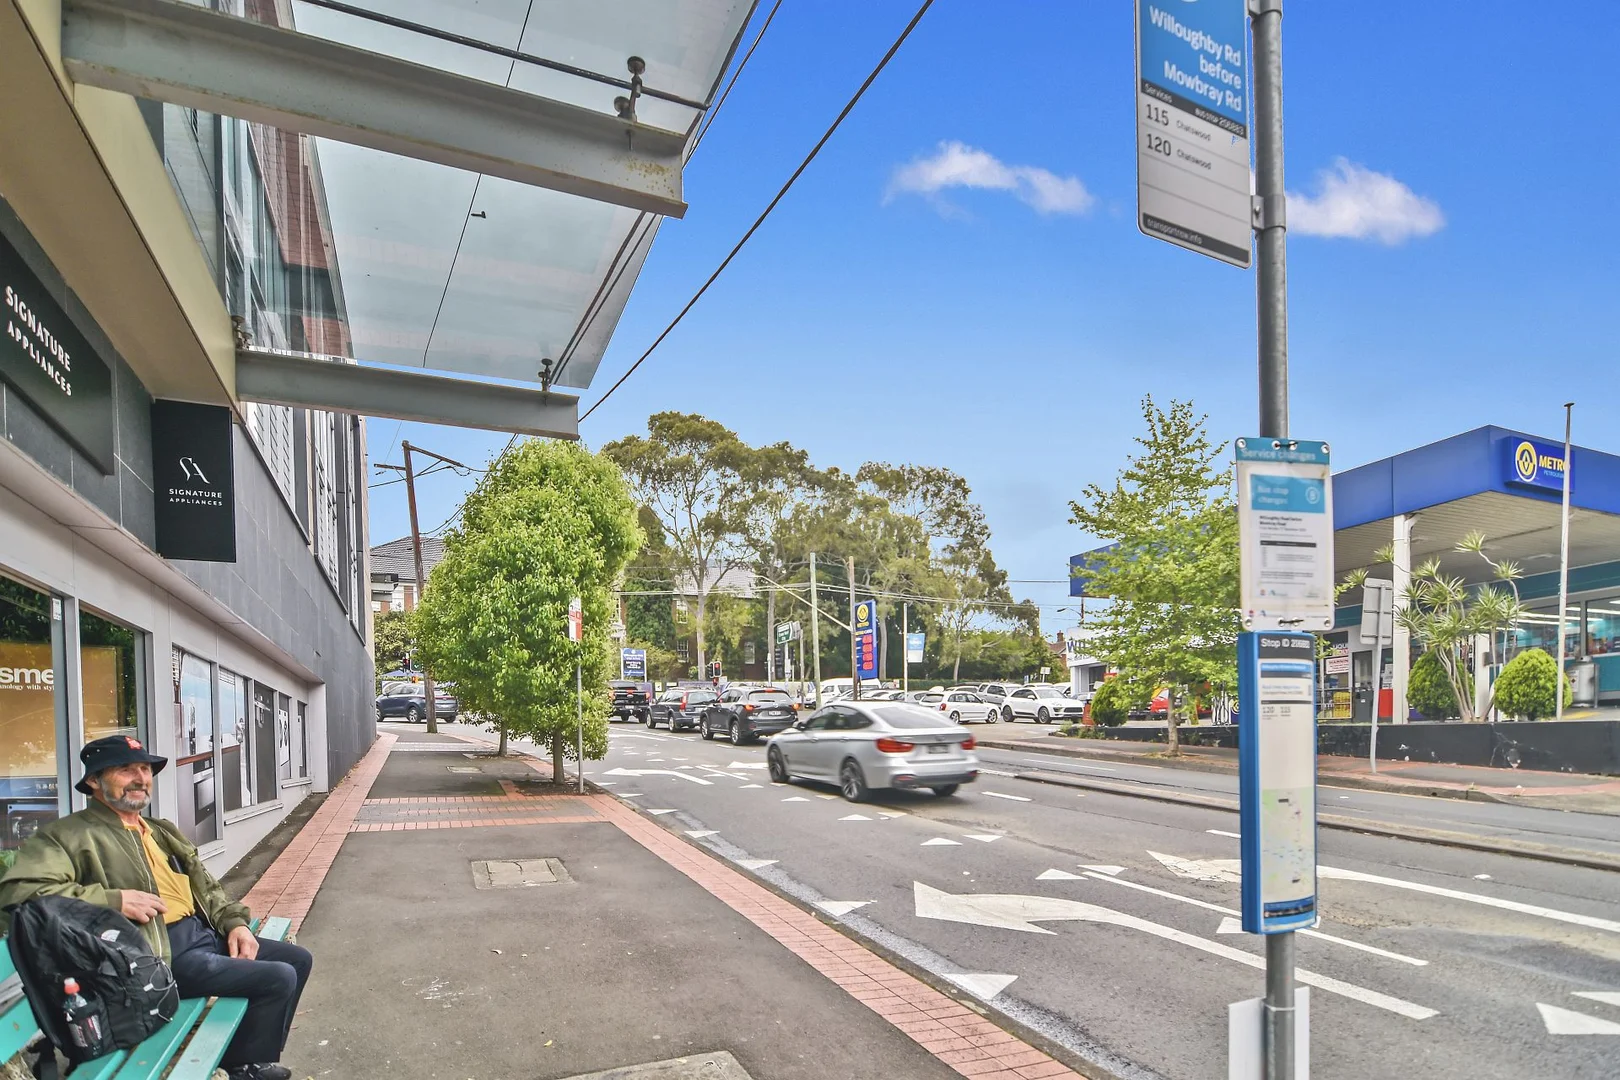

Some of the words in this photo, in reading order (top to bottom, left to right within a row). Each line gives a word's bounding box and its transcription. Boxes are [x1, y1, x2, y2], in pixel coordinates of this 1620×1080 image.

[1149, 5, 1223, 60] Willoughby
[1224, 43, 1241, 67] Rd
[1164, 60, 1224, 106] Mowbray
[1225, 89, 1241, 113] Rd
[1200, 54, 1241, 90] before
[1146, 103, 1169, 127] 115
[1146, 133, 1172, 157] 120
[5, 285, 71, 372] SIGNATURE
[7, 320, 72, 396] APPLIANCES
[169, 488, 222, 499] SIGNATURE
[169, 497, 223, 507] APPLIANCES
[1261, 638, 1281, 649] Stop
